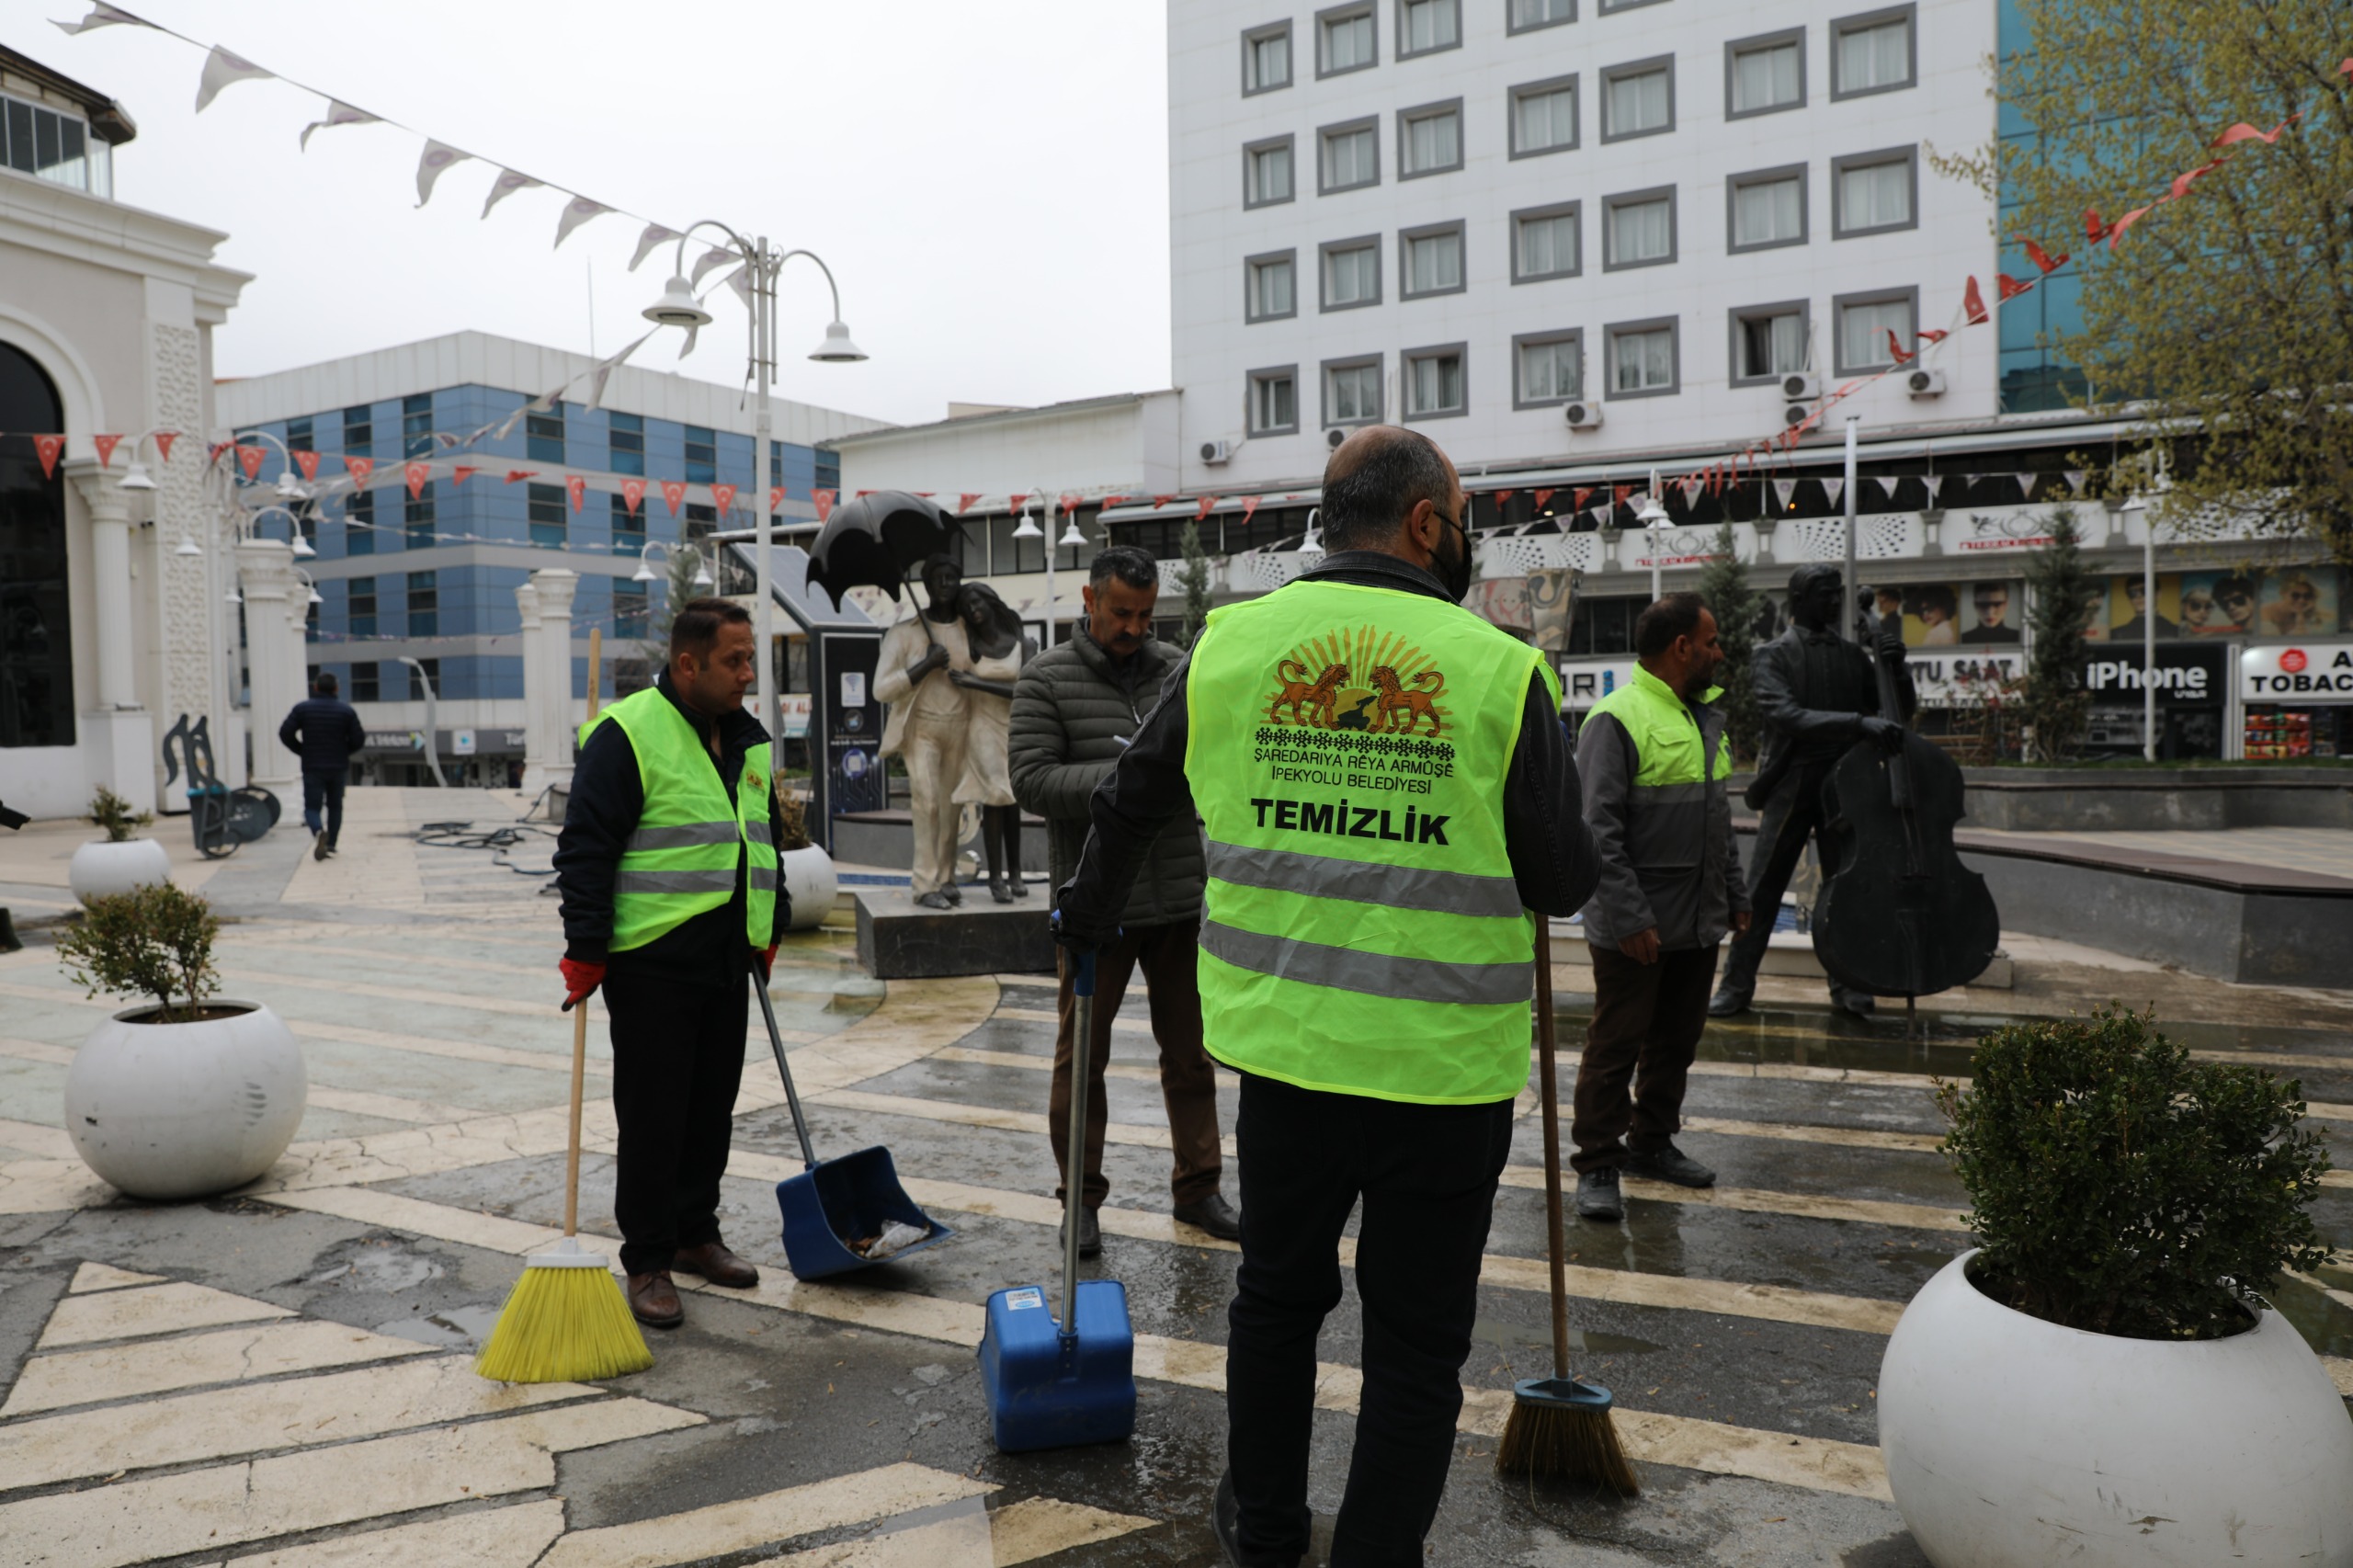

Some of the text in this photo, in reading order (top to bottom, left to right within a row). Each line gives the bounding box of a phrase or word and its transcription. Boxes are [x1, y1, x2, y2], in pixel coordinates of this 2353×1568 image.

[2086, 660, 2208, 689] iPhone
[2250, 674, 2353, 692] TOBAC
[1254, 747, 1454, 778] ŞAREDARIYA RÊYA ARMÛŞÊ
[1272, 766, 1431, 794] İPEKYOLU BELEDİYESİ
[1251, 798, 1451, 846] TEMİZLİK
